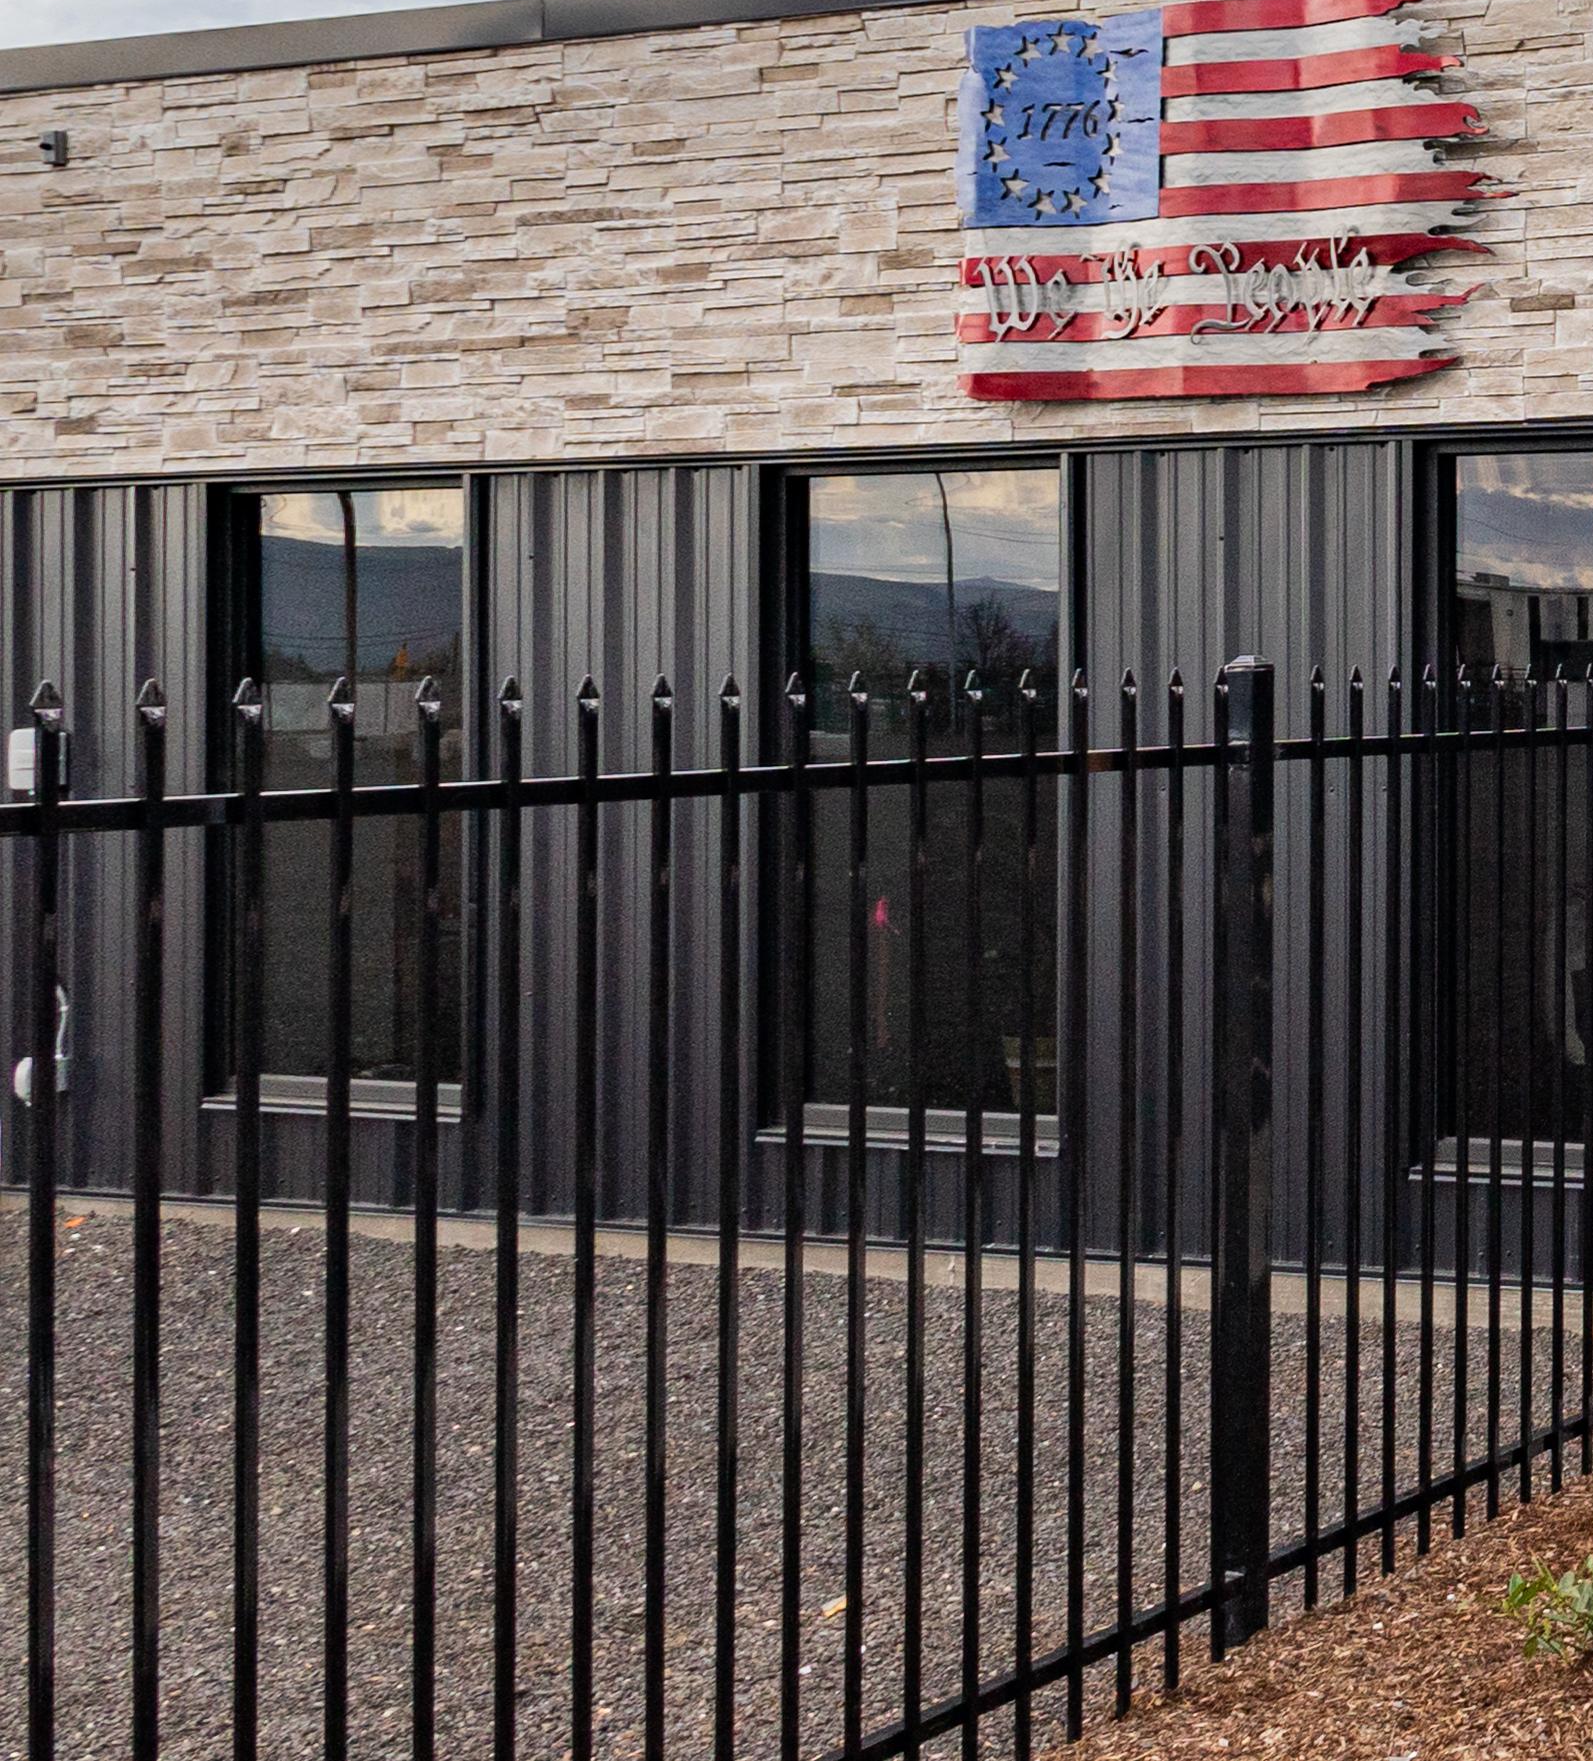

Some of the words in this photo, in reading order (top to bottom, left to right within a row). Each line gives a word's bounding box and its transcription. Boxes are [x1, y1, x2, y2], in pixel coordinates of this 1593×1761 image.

[1017, 100, 1100, 141] 1776
[973, 255, 1077, 343] We
[1188, 225, 1375, 346] People
